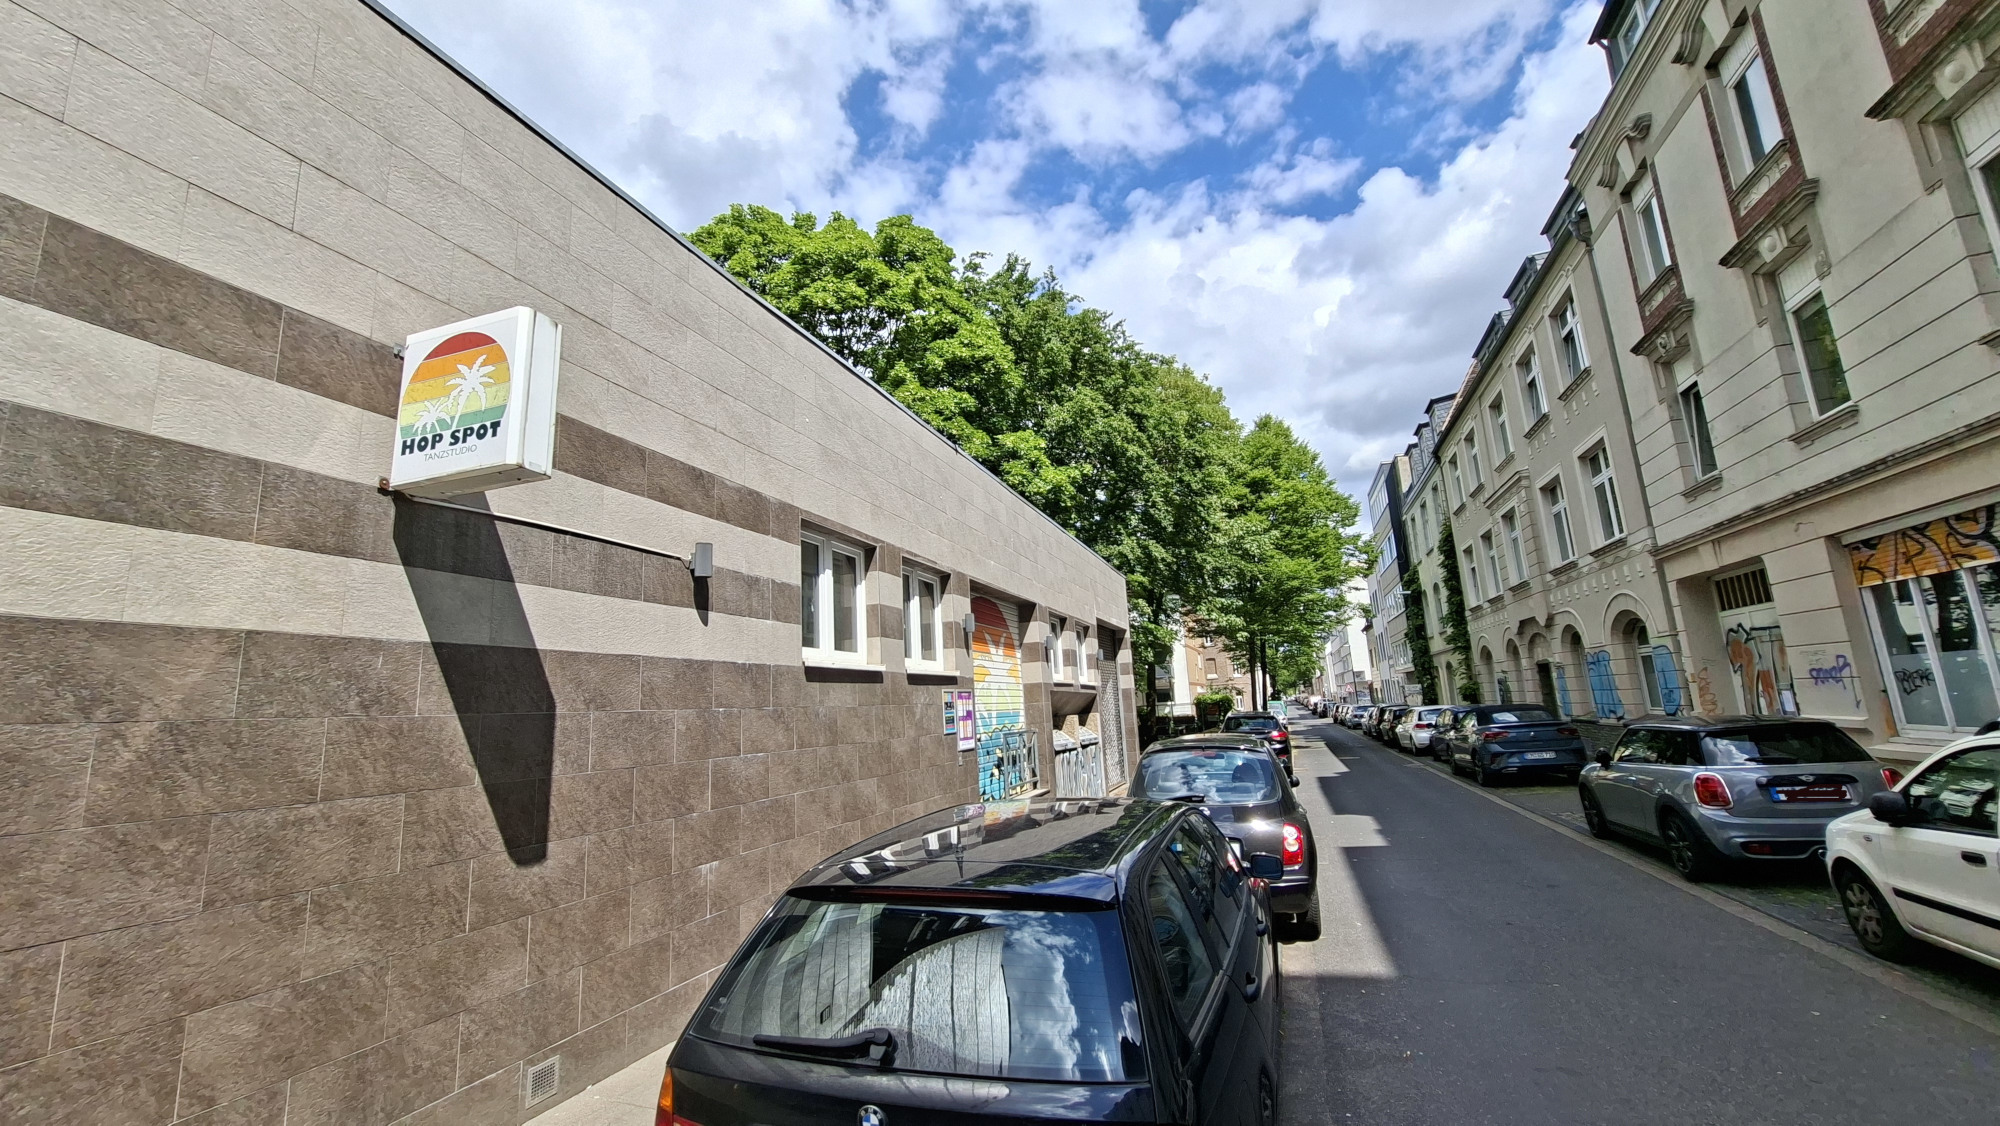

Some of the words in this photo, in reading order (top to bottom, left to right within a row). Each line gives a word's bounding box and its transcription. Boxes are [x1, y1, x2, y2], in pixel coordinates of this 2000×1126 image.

[401, 433, 444, 456] HOP
[449, 420, 501, 446] SPOT
[424, 444, 478, 461] TANZSTUDIO
